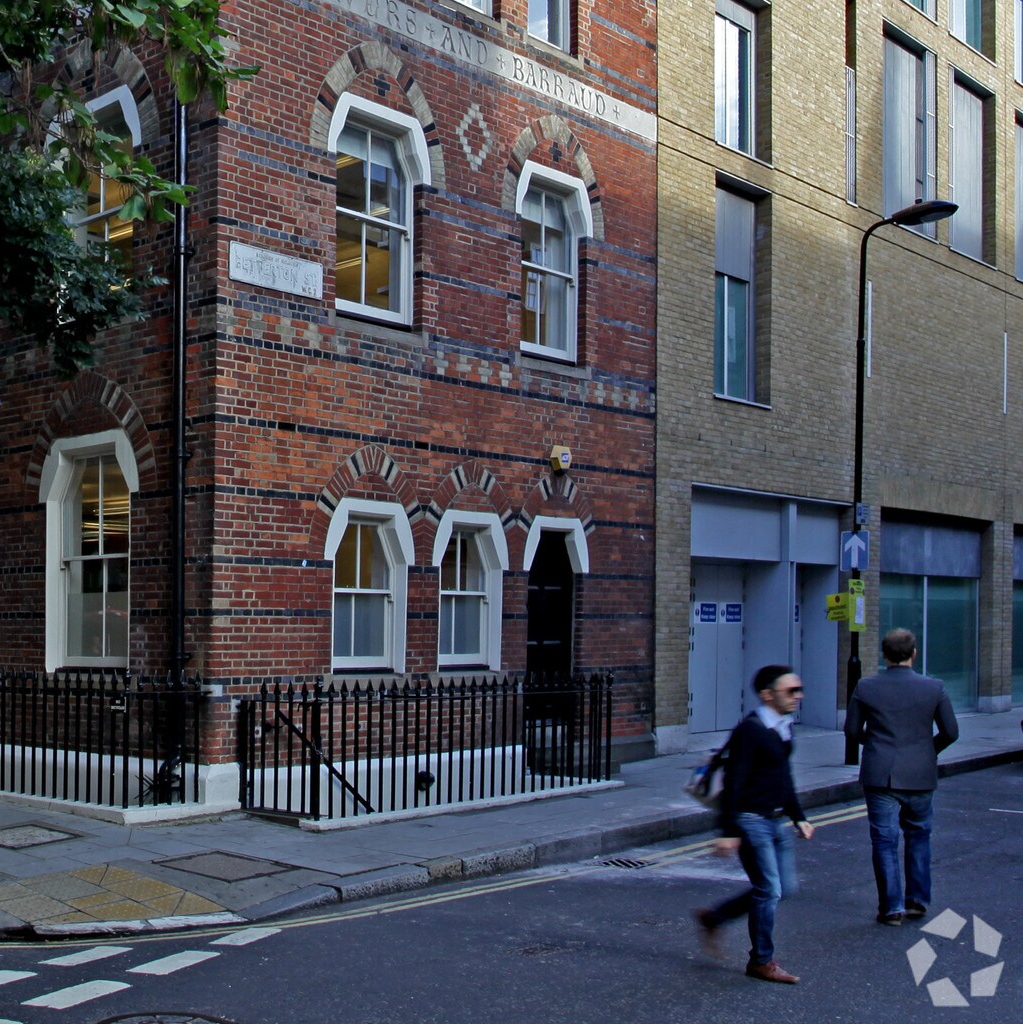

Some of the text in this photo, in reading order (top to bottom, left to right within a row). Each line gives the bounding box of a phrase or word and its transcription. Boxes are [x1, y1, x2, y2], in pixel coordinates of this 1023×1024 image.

[440, 25, 488, 65] AND
[512, 55, 606, 116] BARRAUD
[235, 253, 298, 283] BETTERTON
